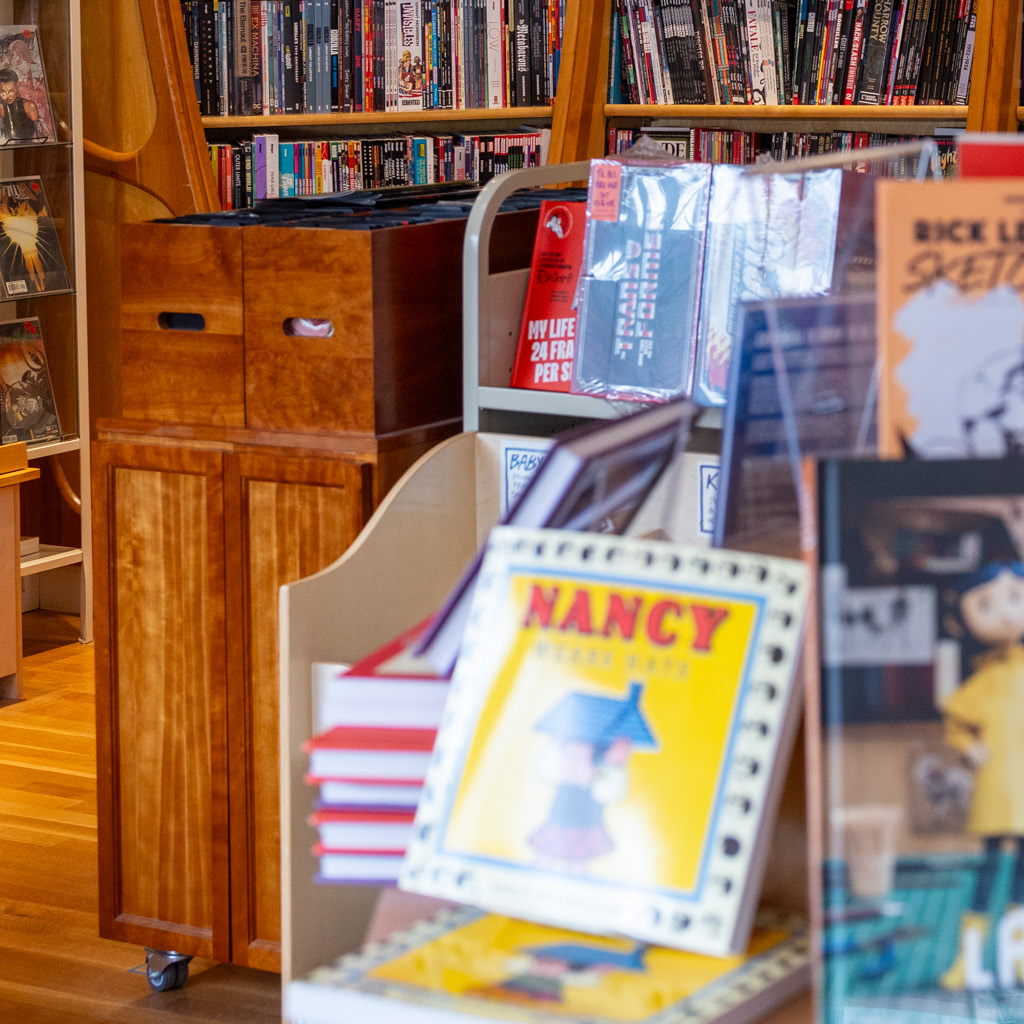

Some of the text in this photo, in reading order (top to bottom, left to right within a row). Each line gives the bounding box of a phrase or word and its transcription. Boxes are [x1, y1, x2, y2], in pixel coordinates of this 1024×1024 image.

[748, 11, 758, 53] FATALE
[914, 220, 986, 245] RICK
[528, 318, 575, 340] MY LIFE
[531, 343, 548, 362] 24
[534, 364, 559, 383] PER
[523, 583, 731, 653] NANCY
